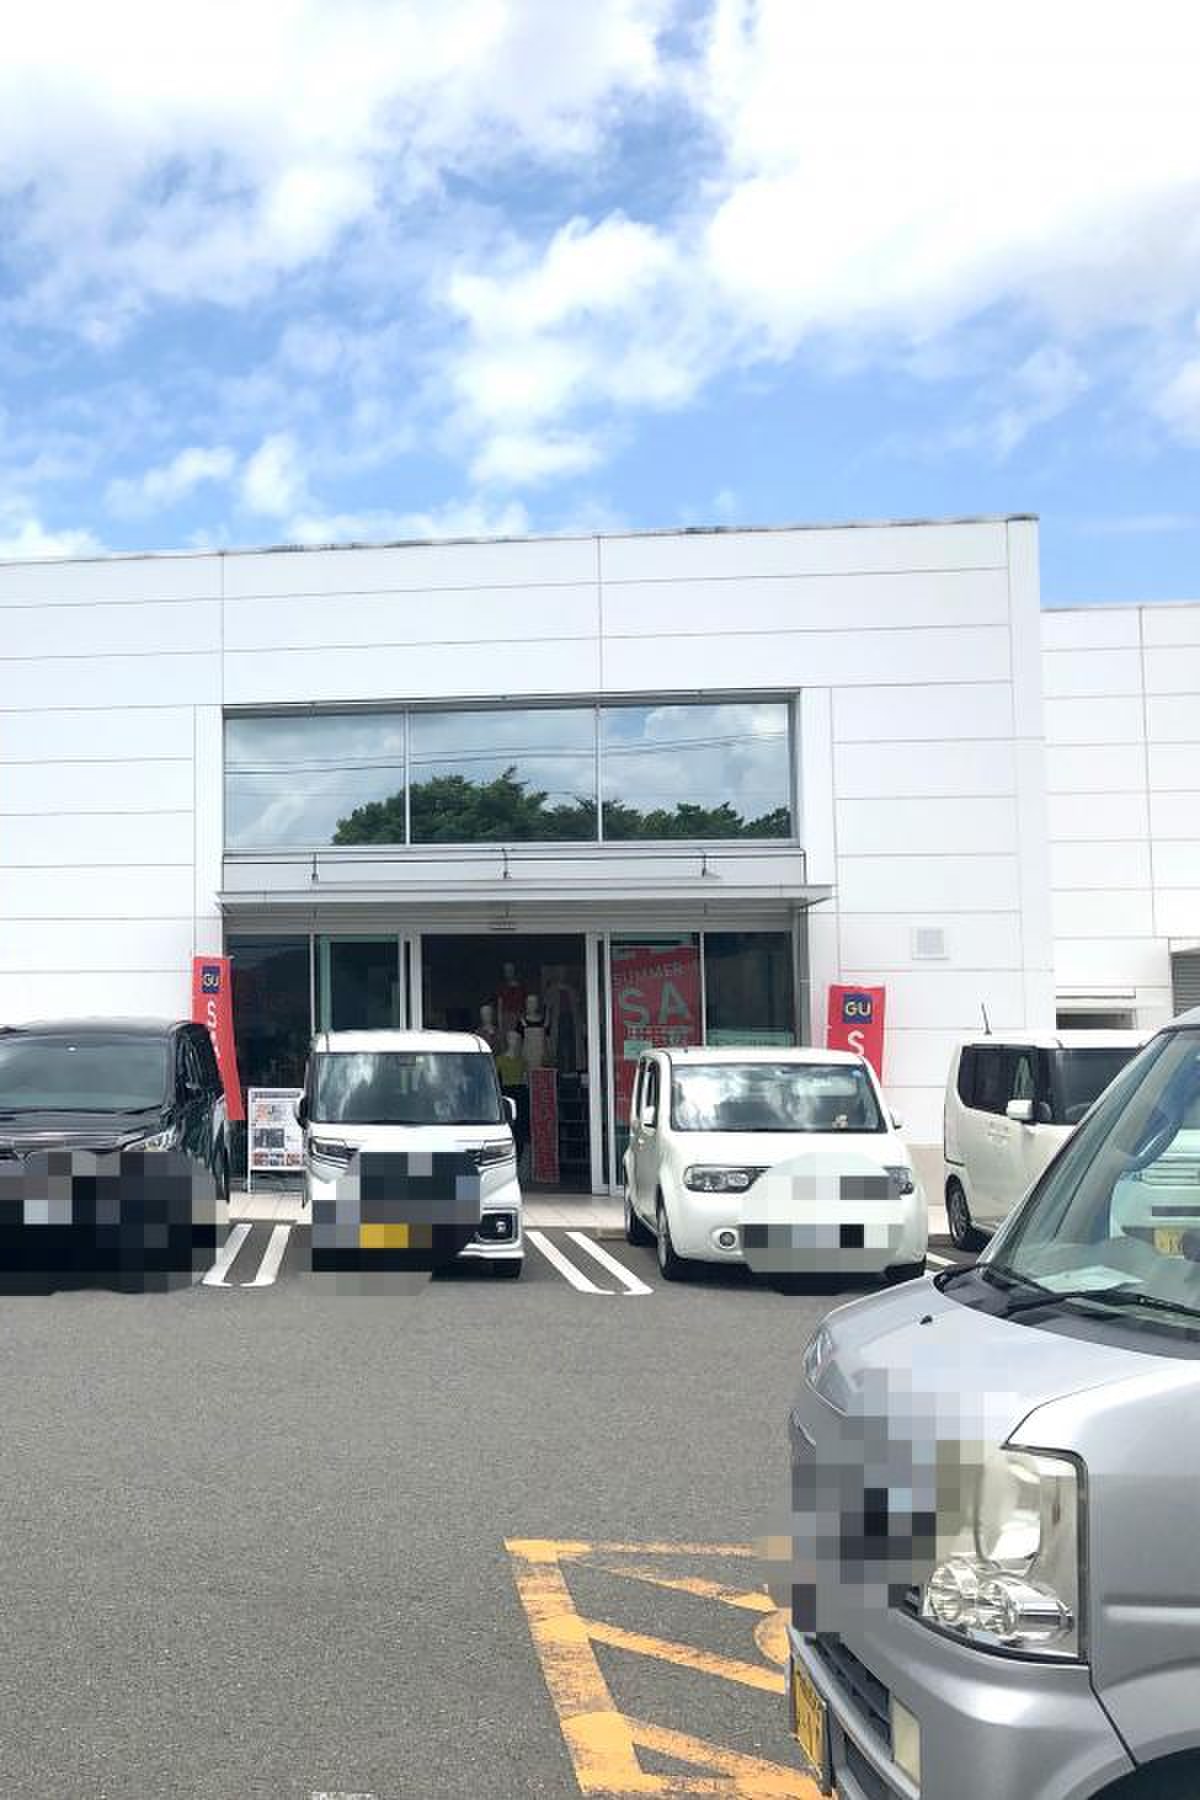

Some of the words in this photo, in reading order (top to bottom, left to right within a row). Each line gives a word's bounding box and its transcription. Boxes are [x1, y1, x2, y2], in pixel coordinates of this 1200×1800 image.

[203, 974, 218, 987] GU
[612, 960, 685, 991] SUMMER
[618, 980, 691, 1027] SA
[845, 1001, 871, 1016] GU
[848, 1030, 865, 1056] S
